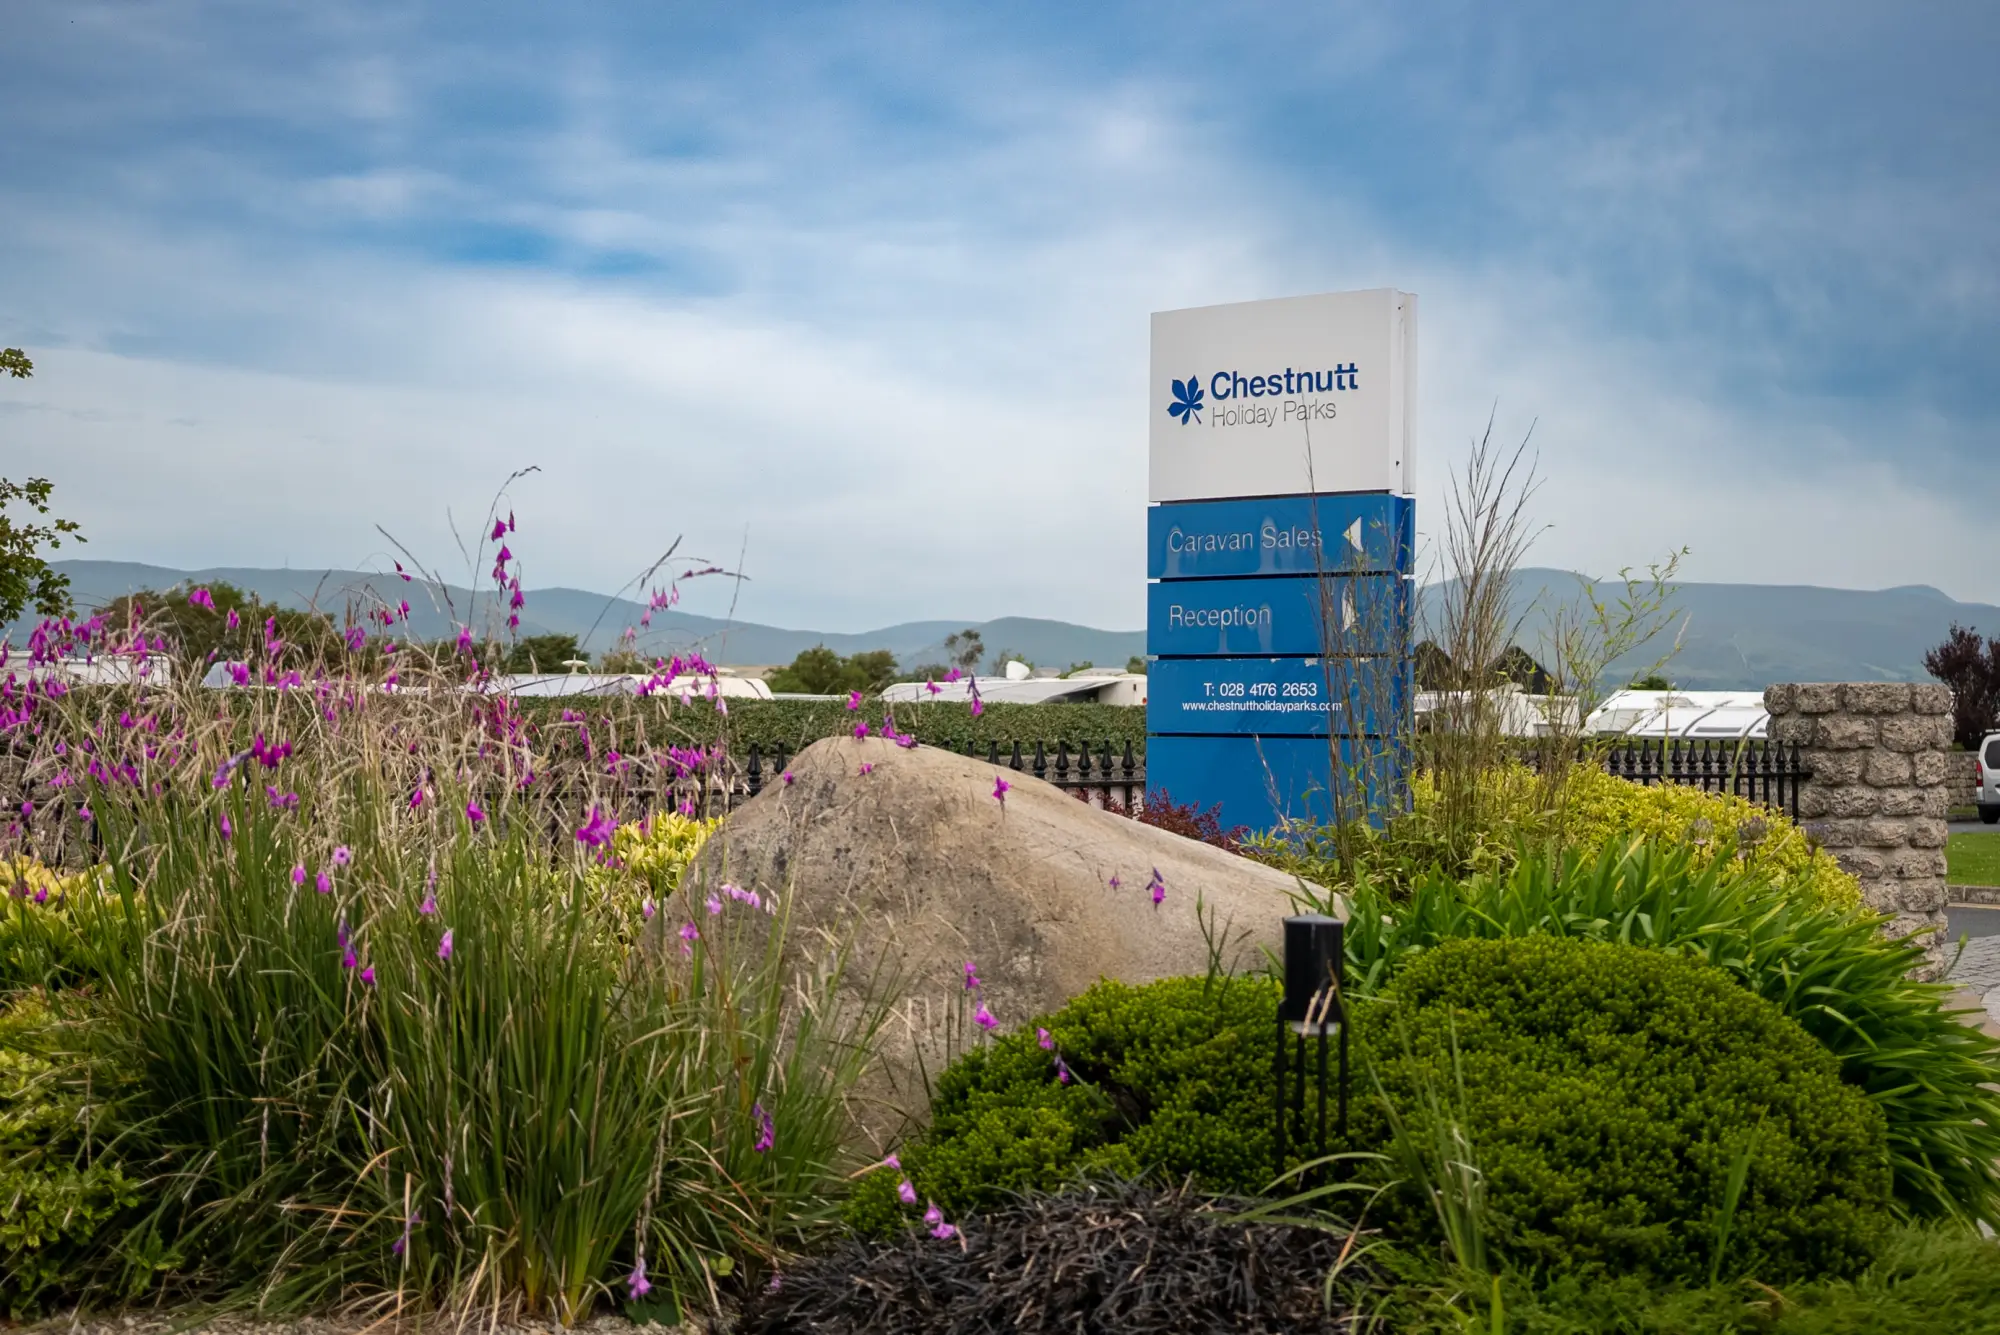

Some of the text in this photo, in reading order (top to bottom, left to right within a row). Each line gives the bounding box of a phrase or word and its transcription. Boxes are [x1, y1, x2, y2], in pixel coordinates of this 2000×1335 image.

[1210, 362, 1359, 400] Chestnutt
[1211, 400, 1336, 428] Holiday Parks
[1169, 525, 1323, 552] Caravan Sales
[1169, 604, 1271, 629] Reception
[1203, 682, 1318, 697] T: 028 4176 2653
